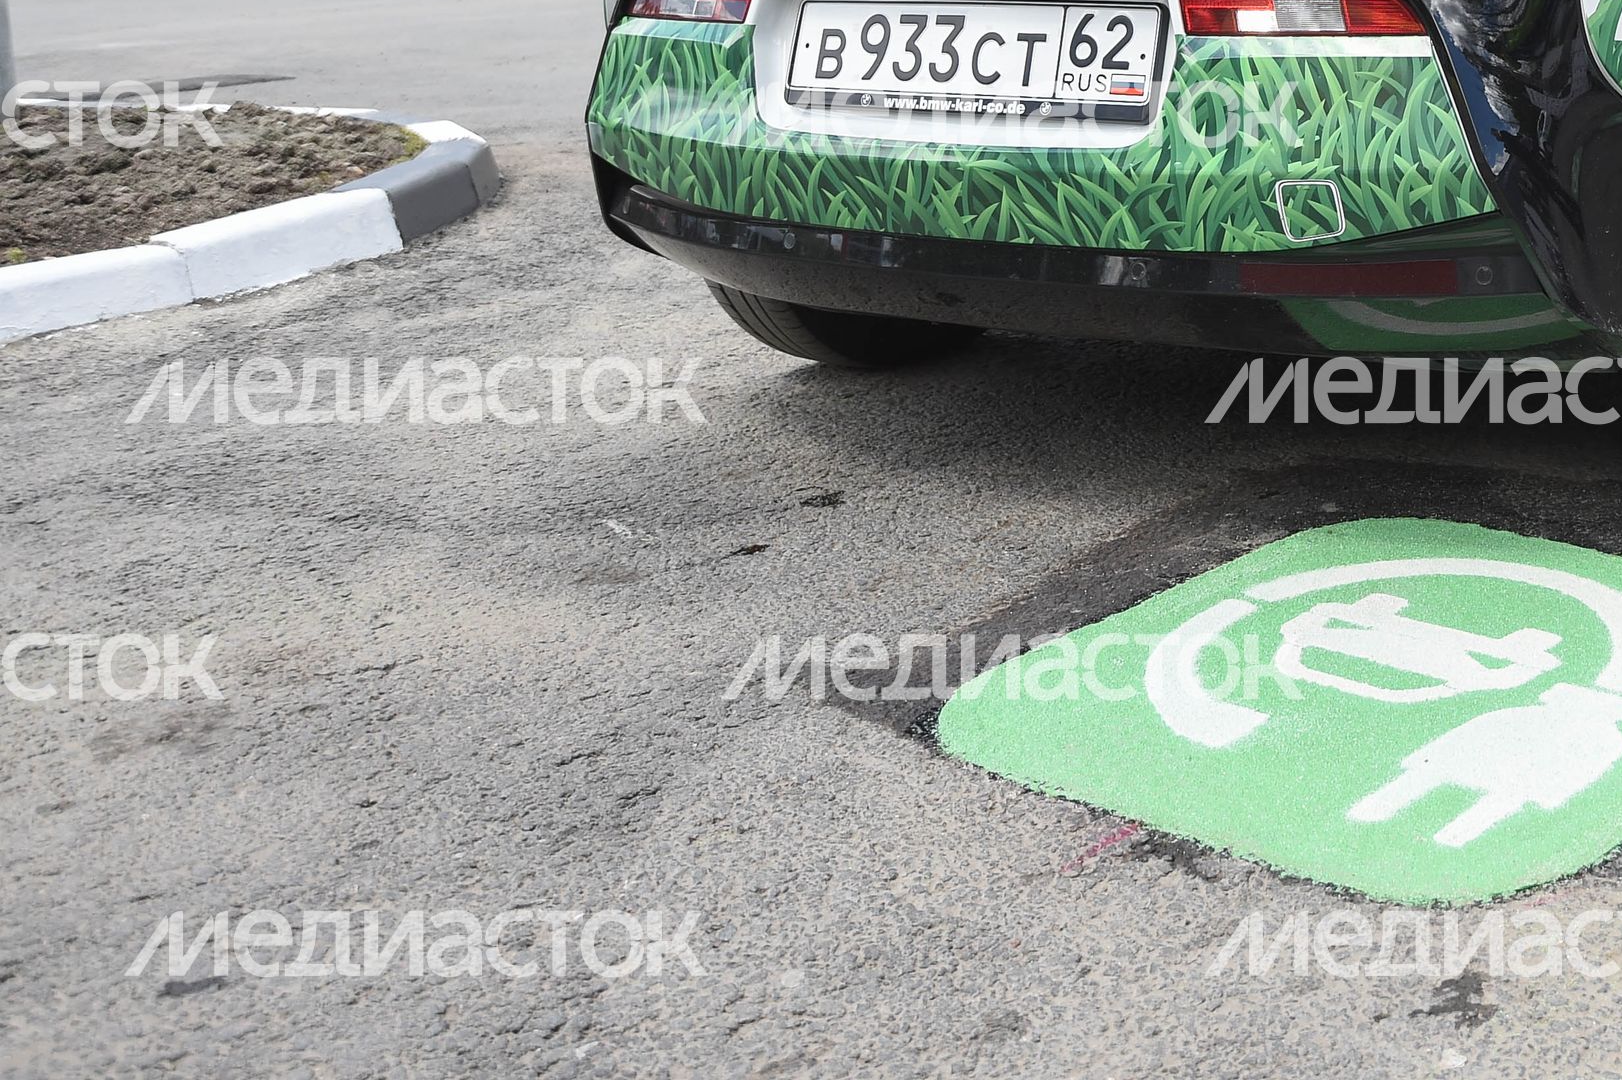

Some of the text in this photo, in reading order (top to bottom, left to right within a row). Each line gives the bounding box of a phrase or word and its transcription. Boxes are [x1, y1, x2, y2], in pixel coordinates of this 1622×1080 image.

[1069, 13, 1134, 71] 62
[1062, 73, 1107, 93] RUS
[883, 94, 1026, 115] www.bmw-karl-co.de
